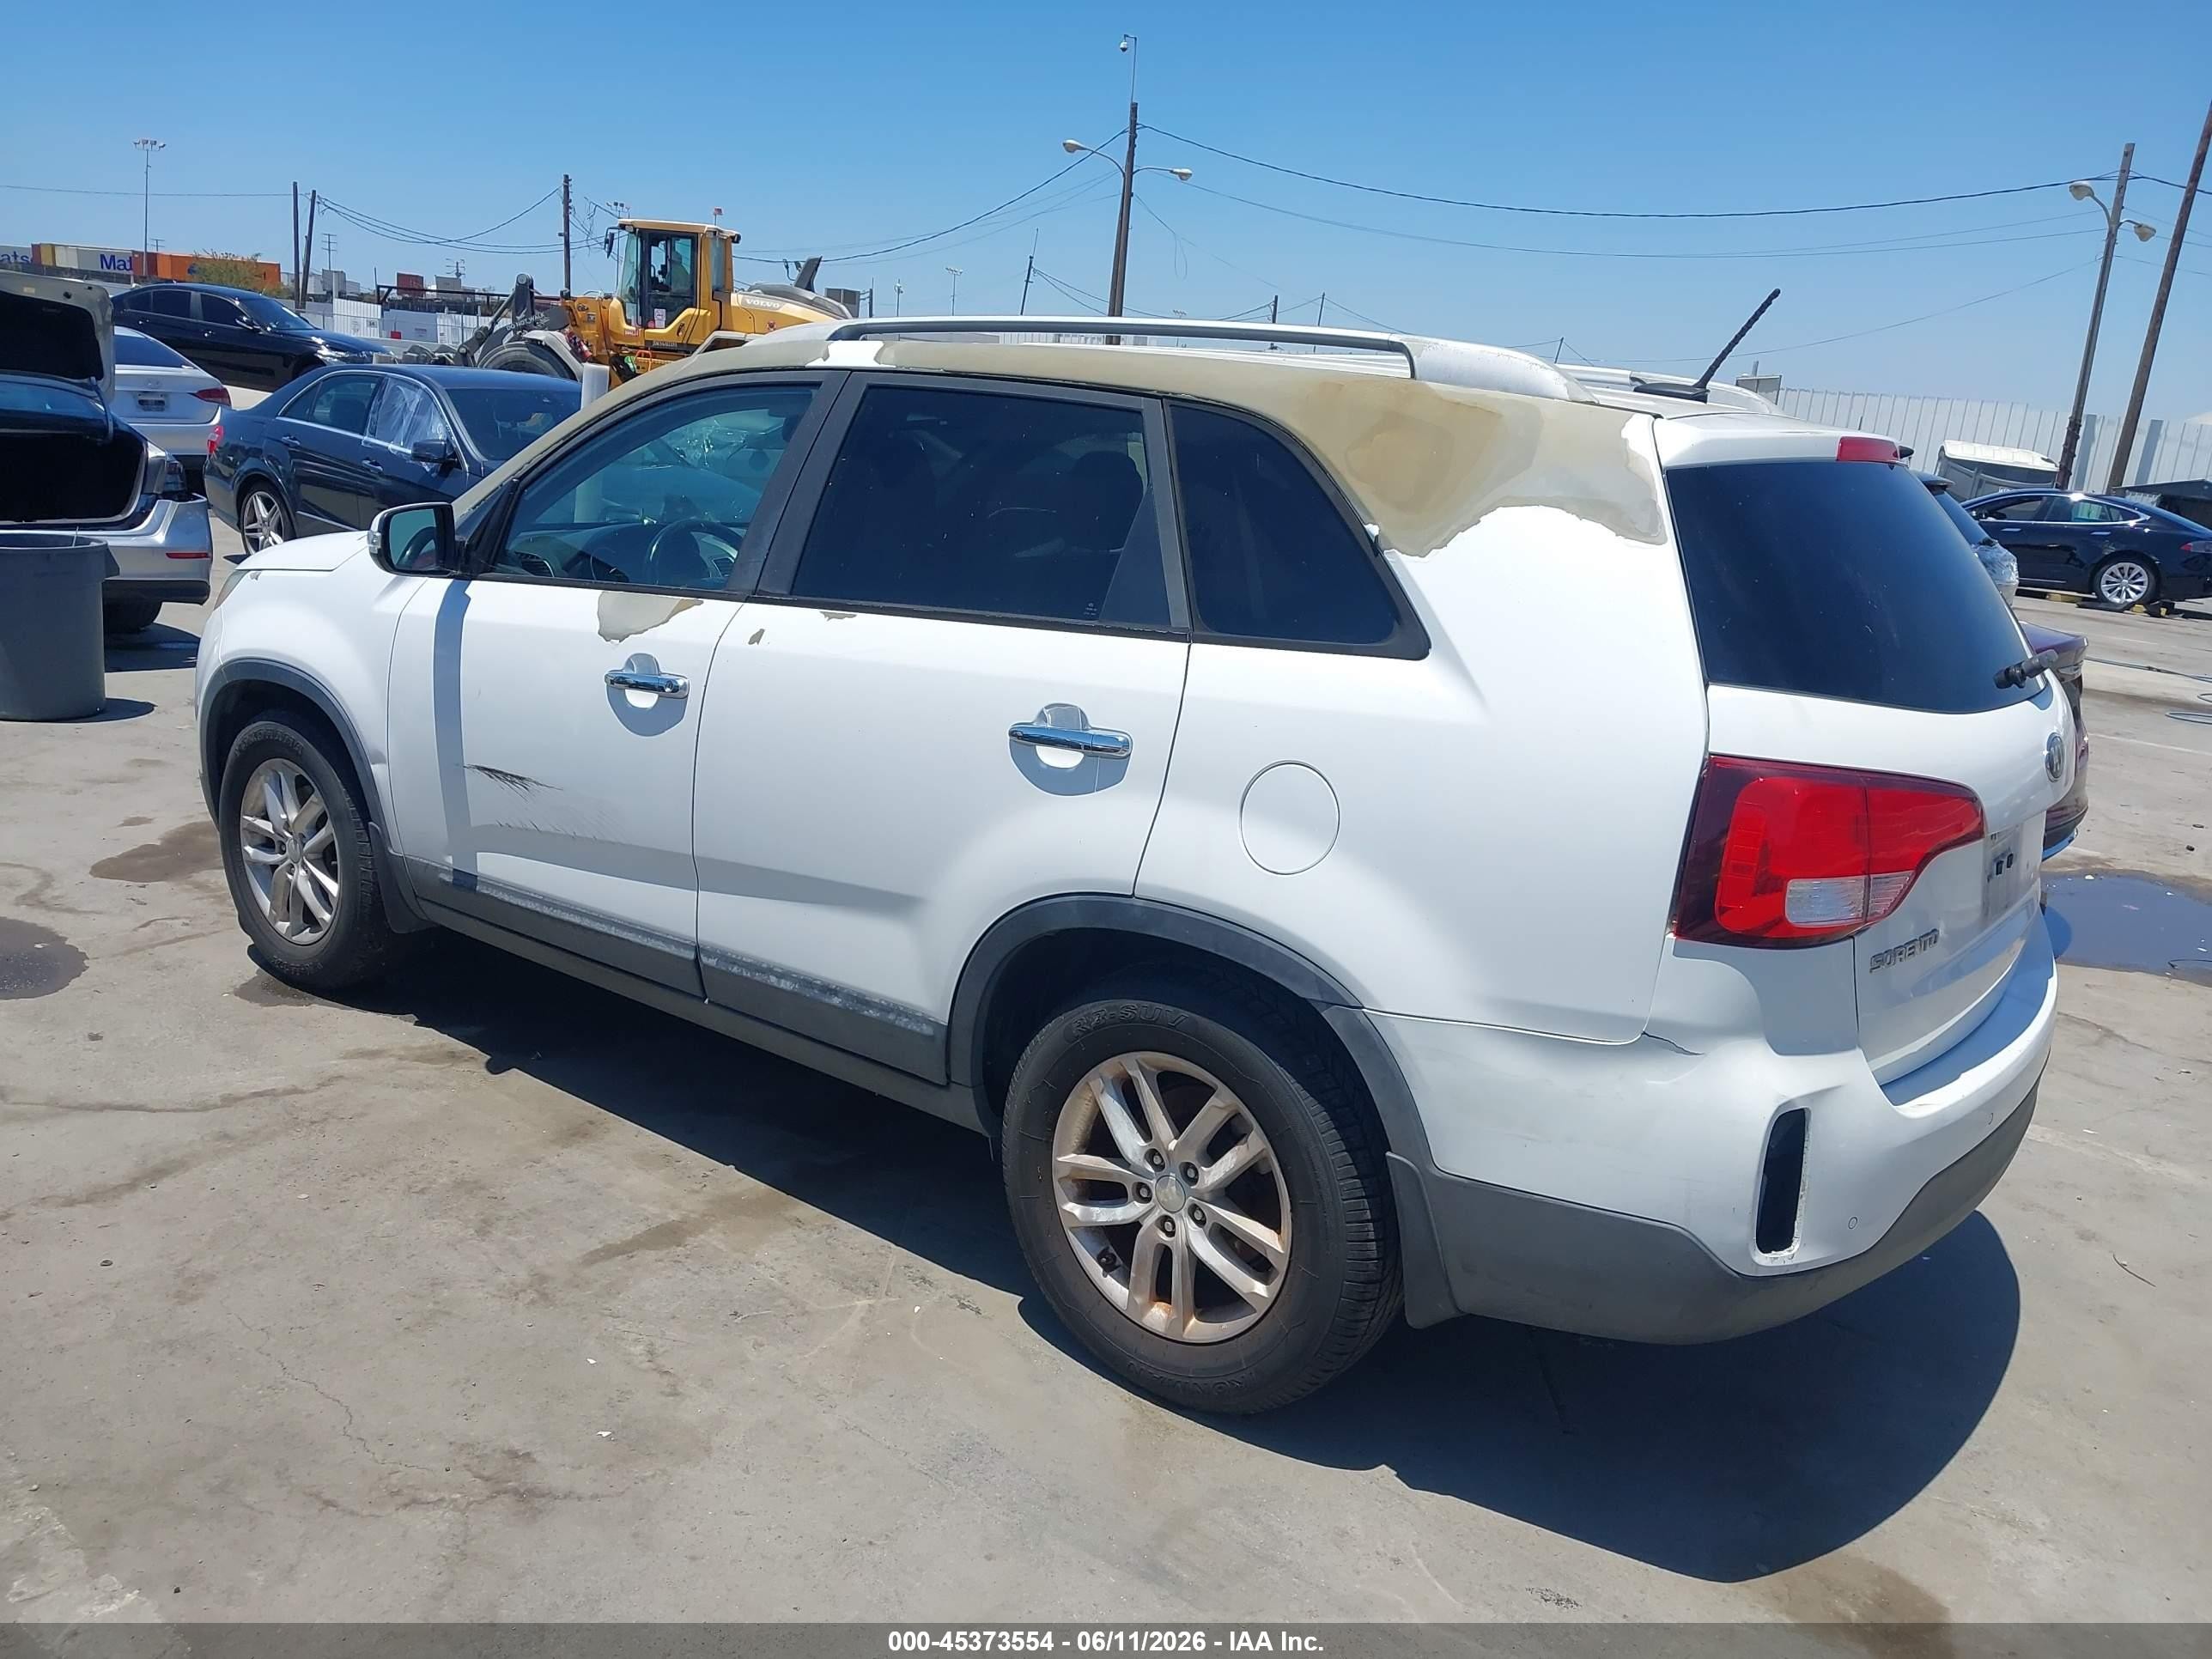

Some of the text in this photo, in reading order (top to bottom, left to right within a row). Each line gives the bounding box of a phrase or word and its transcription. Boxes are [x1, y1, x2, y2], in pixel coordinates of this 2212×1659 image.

[0, 251, 33, 263] ats
[746, 299, 780, 308] VOLVO
[507, 322, 515, 331] DO
[1869, 928, 1940, 973] SORENTO
